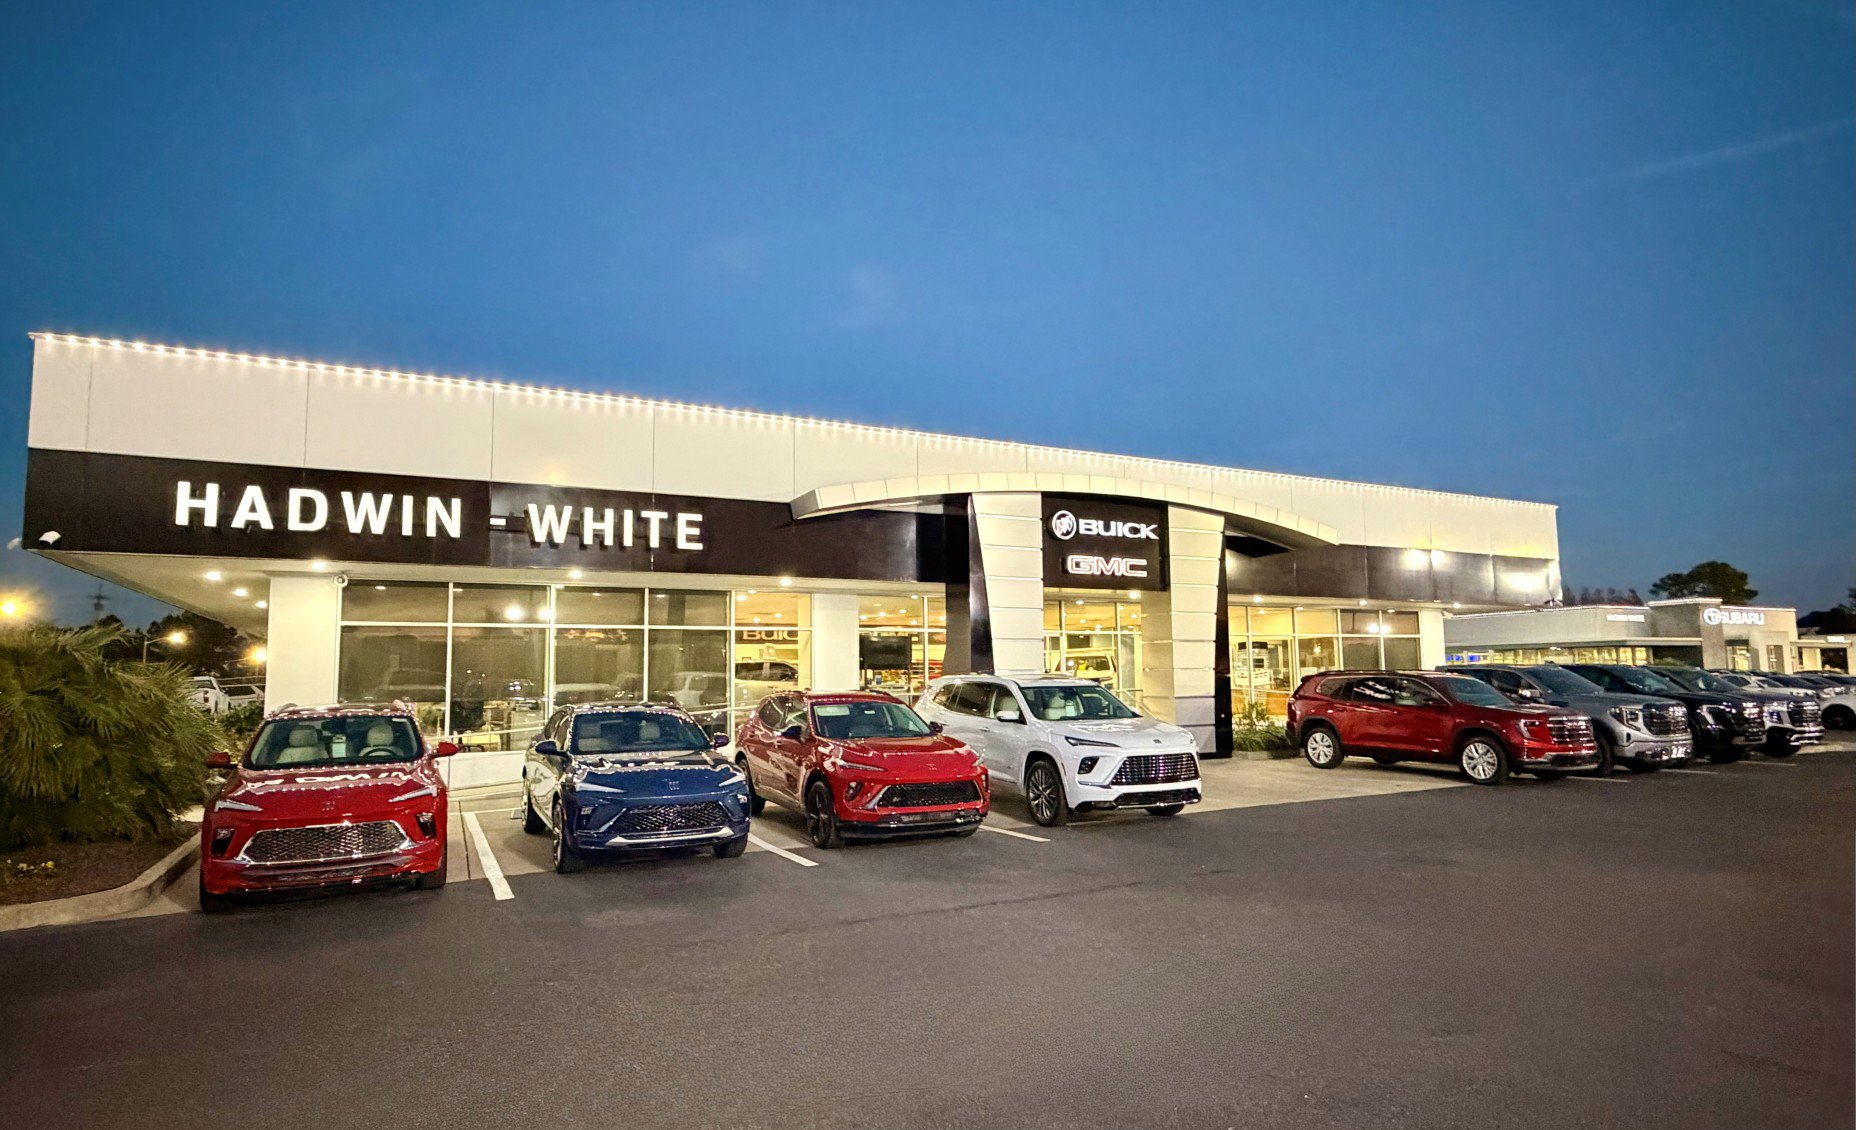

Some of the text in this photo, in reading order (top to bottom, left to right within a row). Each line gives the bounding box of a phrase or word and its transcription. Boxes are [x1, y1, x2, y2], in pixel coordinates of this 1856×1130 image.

[175, 481, 462, 539] HADWIN
[527, 503, 704, 550] WHITE
[1078, 519, 1159, 540] BUICK
[1066, 554, 1148, 578] GMC
[1720, 611, 1765, 625] SUBARU
